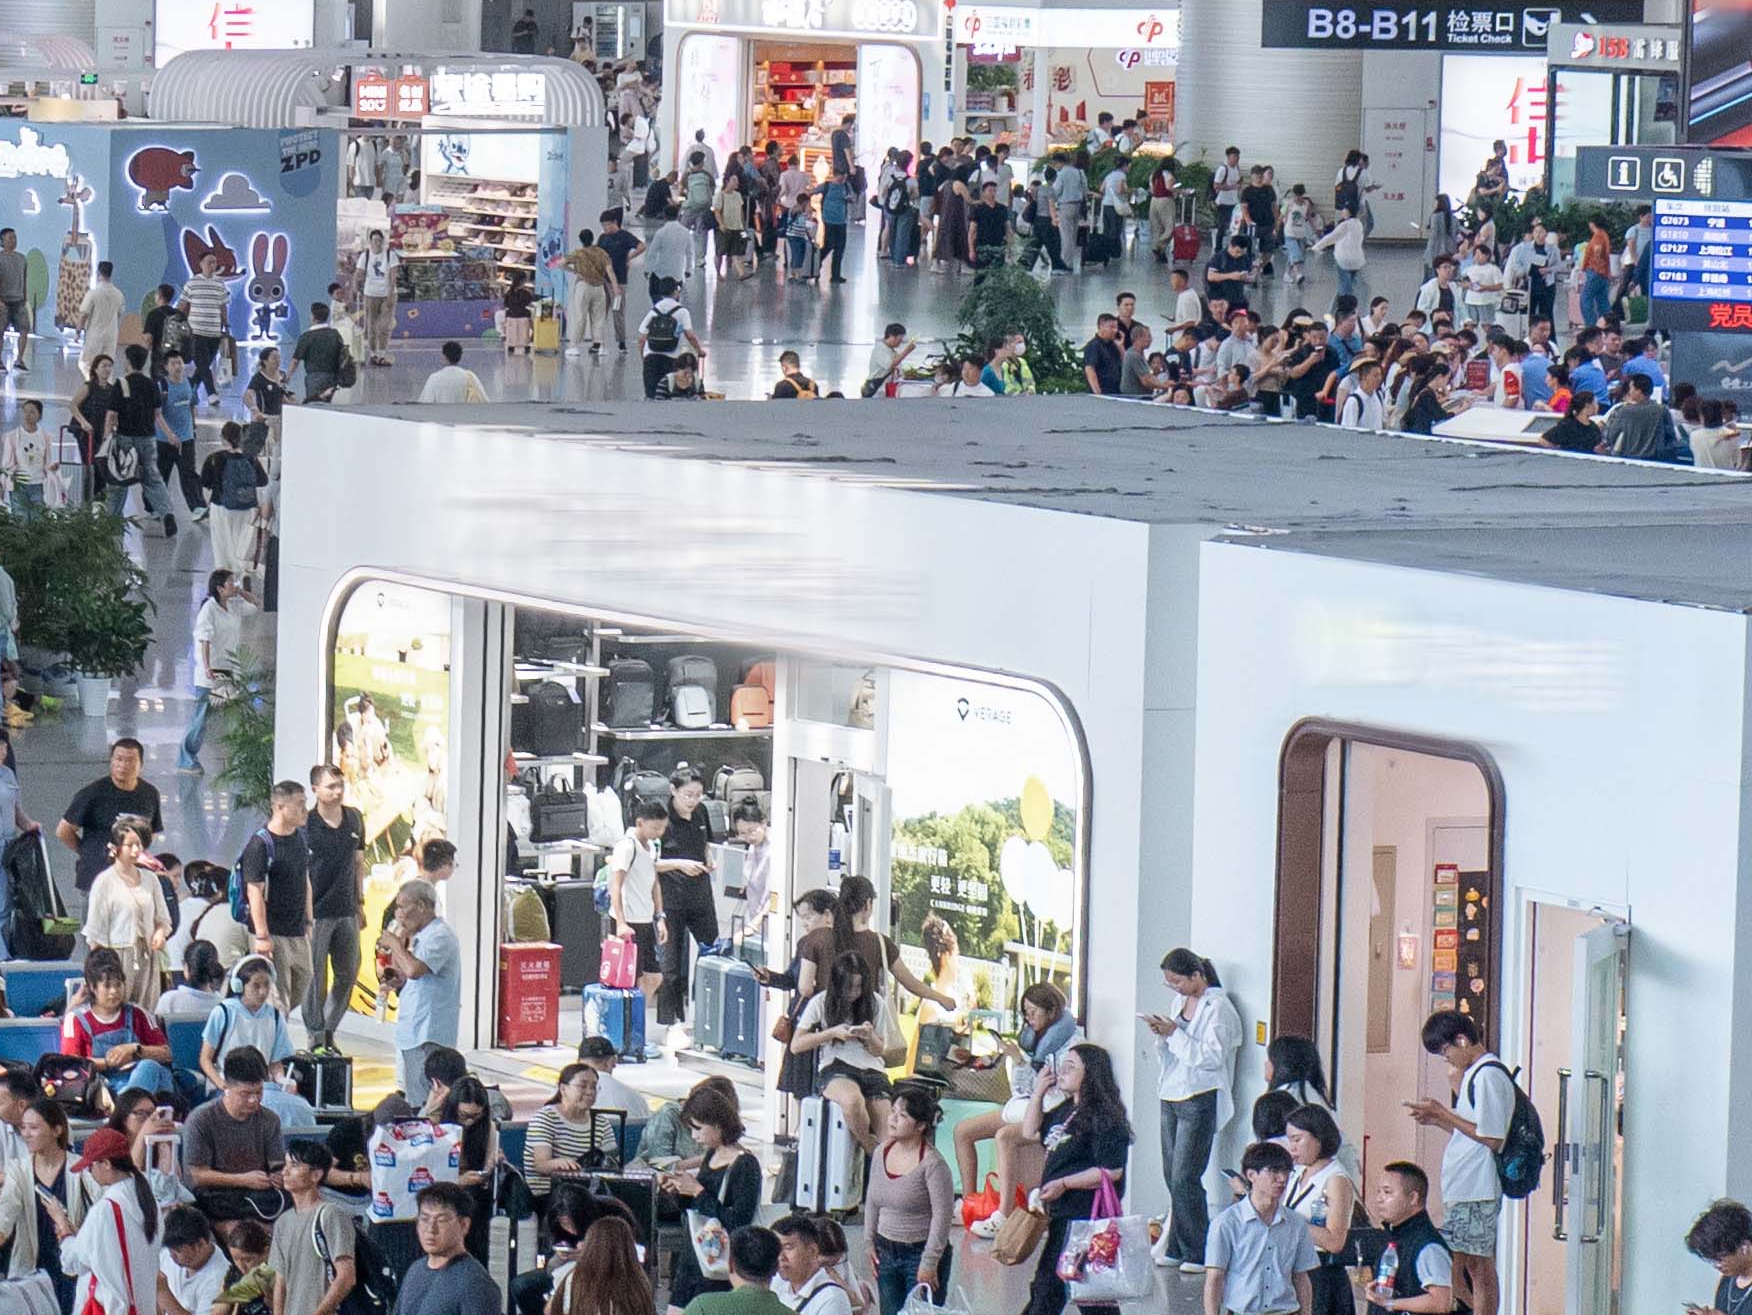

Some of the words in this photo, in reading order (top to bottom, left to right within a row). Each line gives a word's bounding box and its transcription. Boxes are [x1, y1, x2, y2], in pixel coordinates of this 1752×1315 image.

[1307, 8, 1437, 40] B8-B11
[1447, 10, 1514, 33] 检票口
[1447, 33, 1479, 45] Ticket
[1482, 33, 1513, 46] Check
[1598, 37, 1629, 59] 158
[280, 150, 321, 172] ZPD
